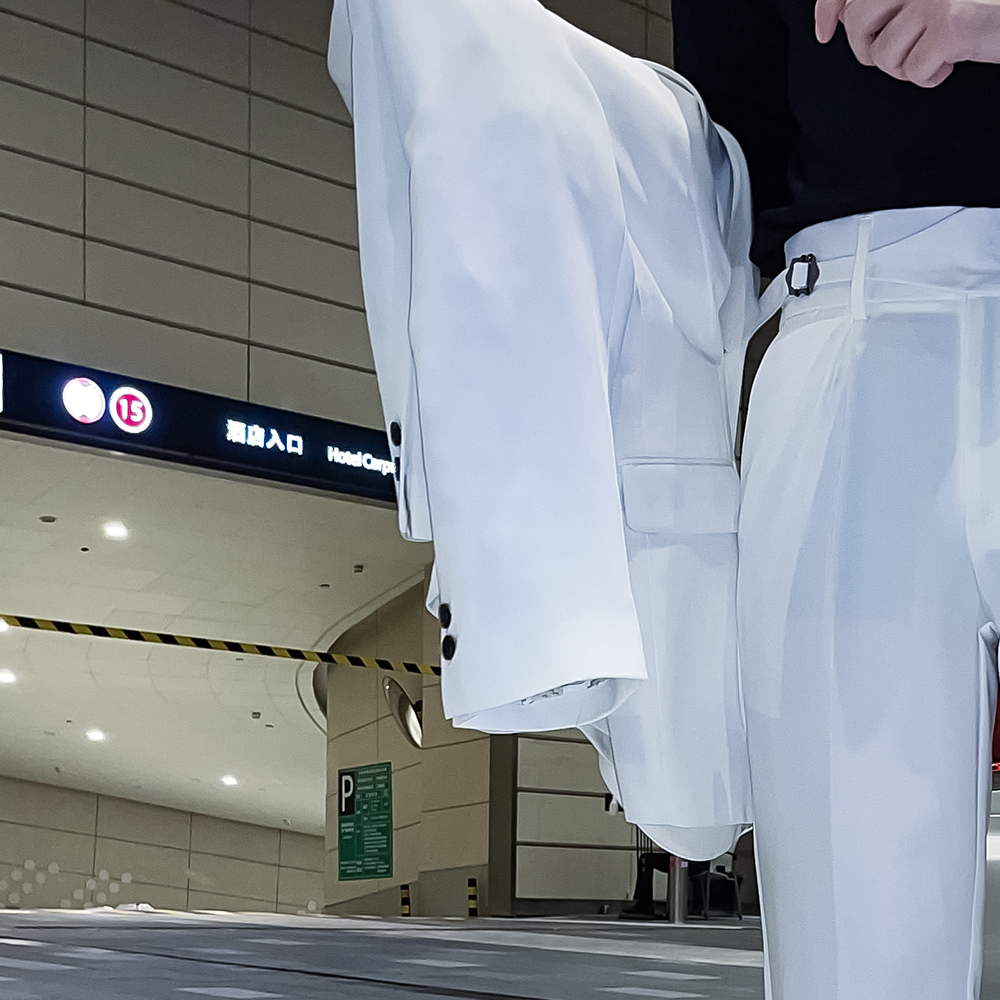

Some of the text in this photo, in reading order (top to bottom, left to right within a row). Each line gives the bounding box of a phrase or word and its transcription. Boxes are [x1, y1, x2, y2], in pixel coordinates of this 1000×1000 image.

[119, 398, 144, 423] 15
[226, 419, 304, 456] 酒店入口
[328, 446, 362, 467] Hotel
[341, 775, 354, 812] P
